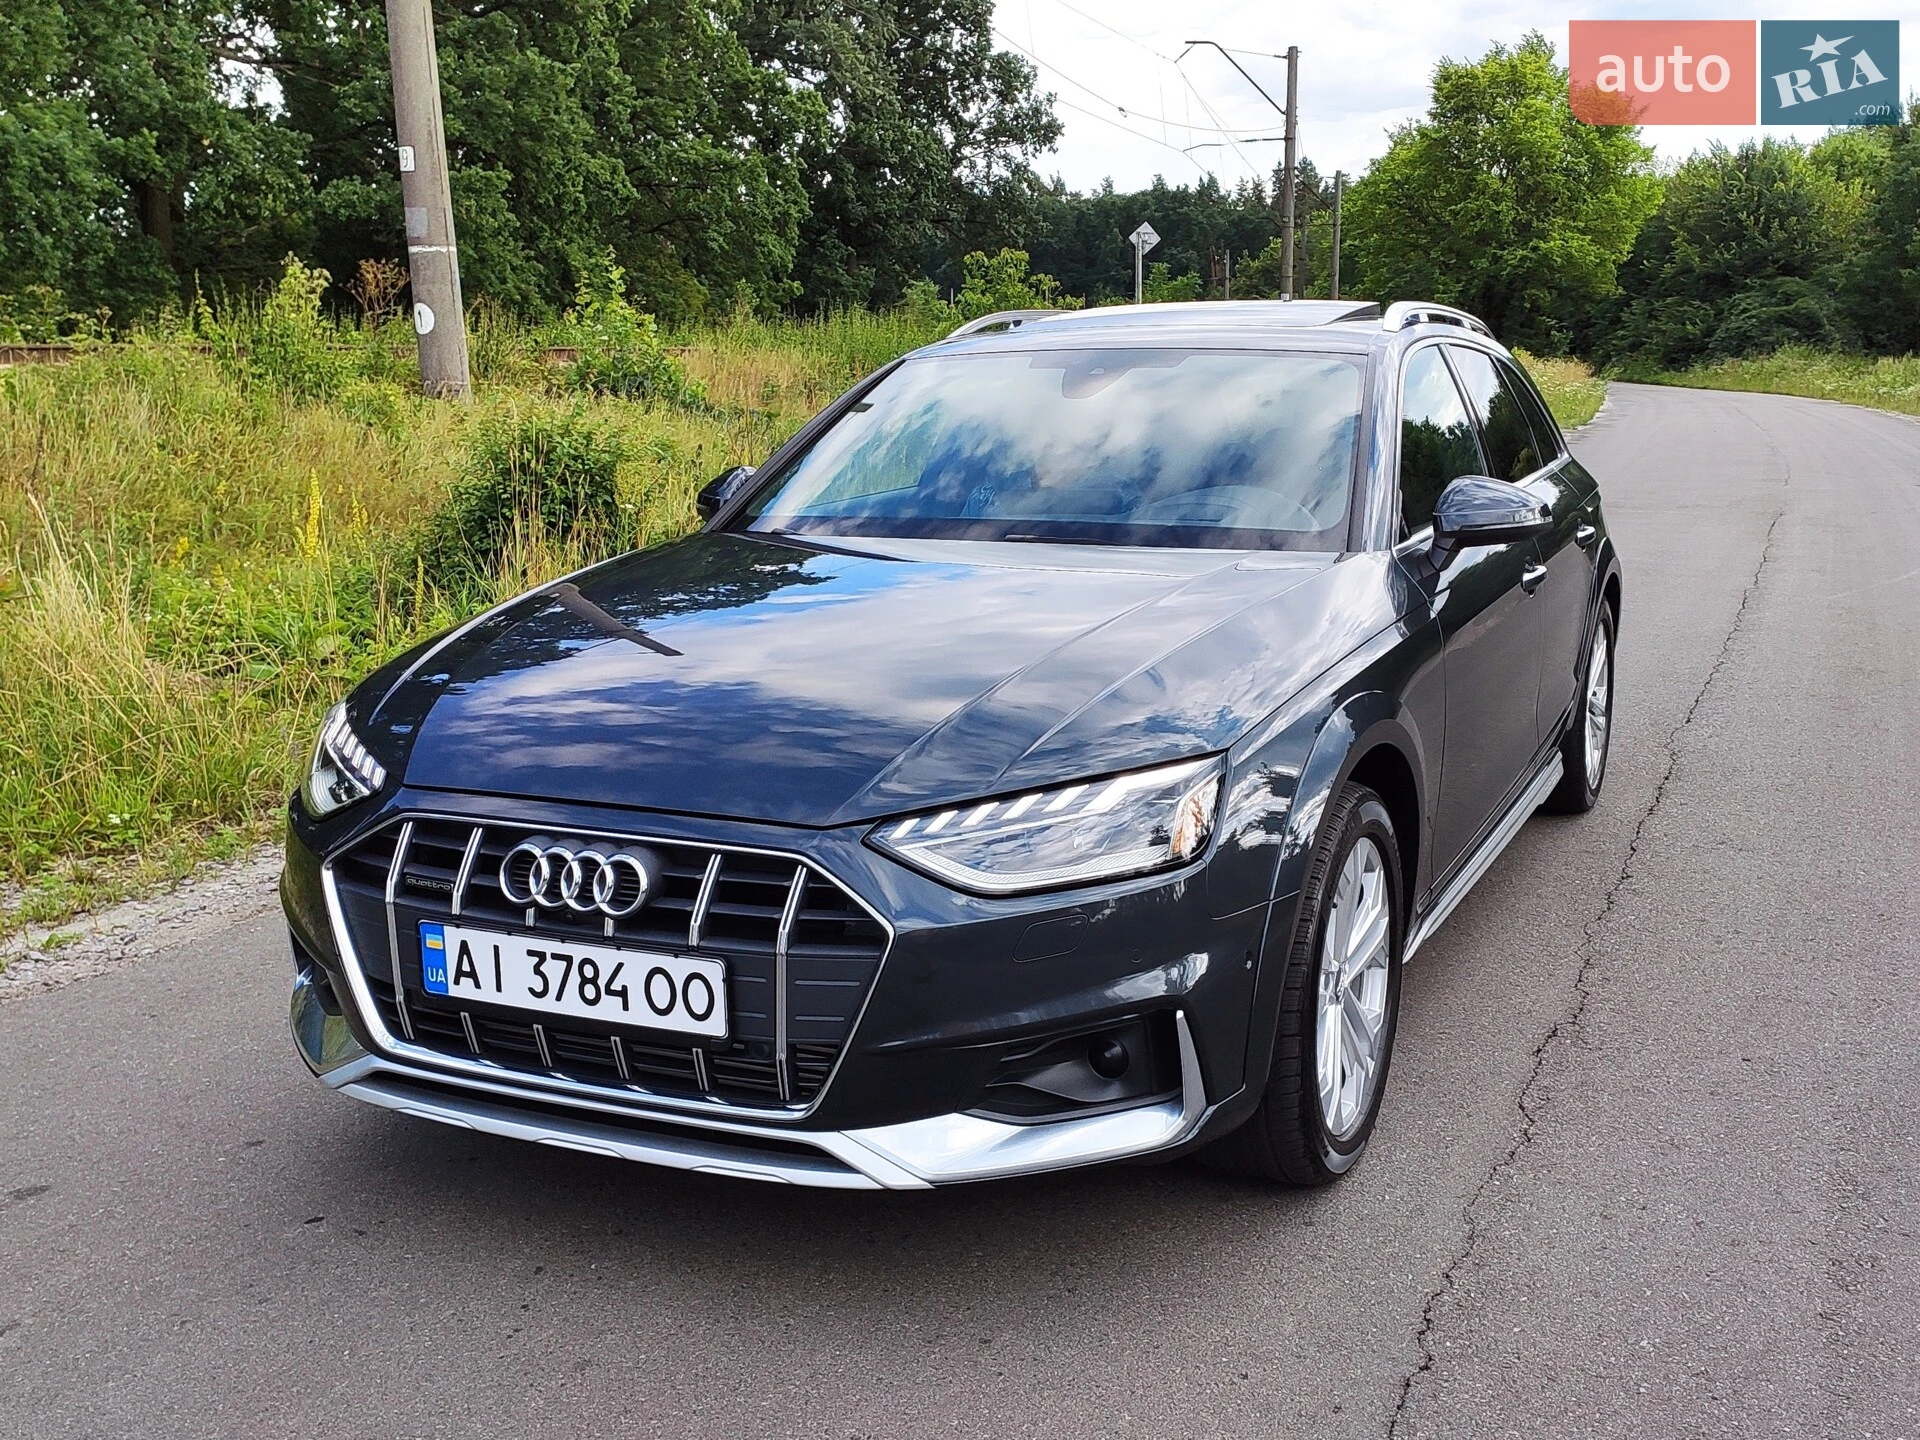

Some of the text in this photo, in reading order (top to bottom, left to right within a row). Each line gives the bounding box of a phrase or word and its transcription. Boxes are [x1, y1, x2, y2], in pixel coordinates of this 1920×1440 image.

[407, 878, 451, 891] quattro
[427, 966, 446, 983] UA
[453, 940, 502, 993] AI
[527, 949, 629, 1012] 3784
